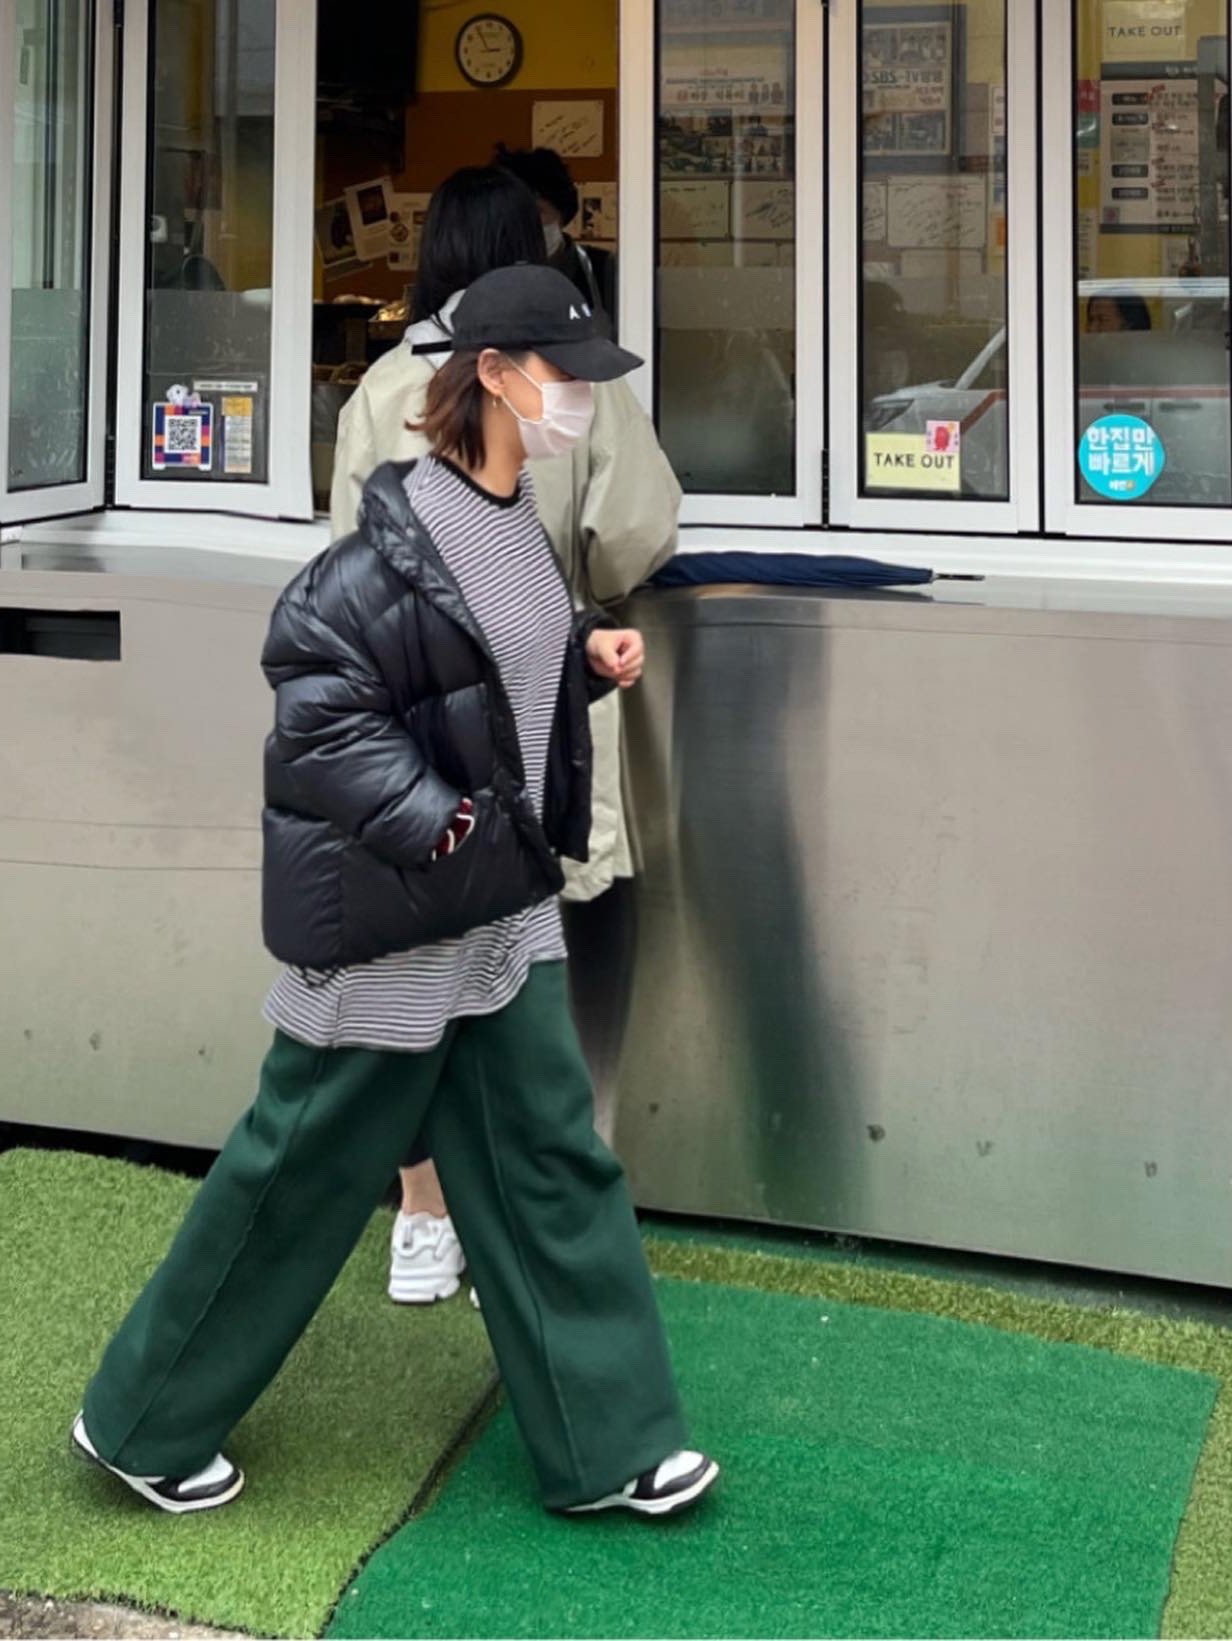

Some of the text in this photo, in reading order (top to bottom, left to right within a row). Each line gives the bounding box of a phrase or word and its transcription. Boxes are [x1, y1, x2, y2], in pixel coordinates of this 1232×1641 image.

[1108, 25, 1181, 37] TAKE OUT
[1086, 426, 1155, 451] 한집만
[874, 452, 954, 469] TAKE OUT
[1088, 451, 1155, 476] 빠르게
